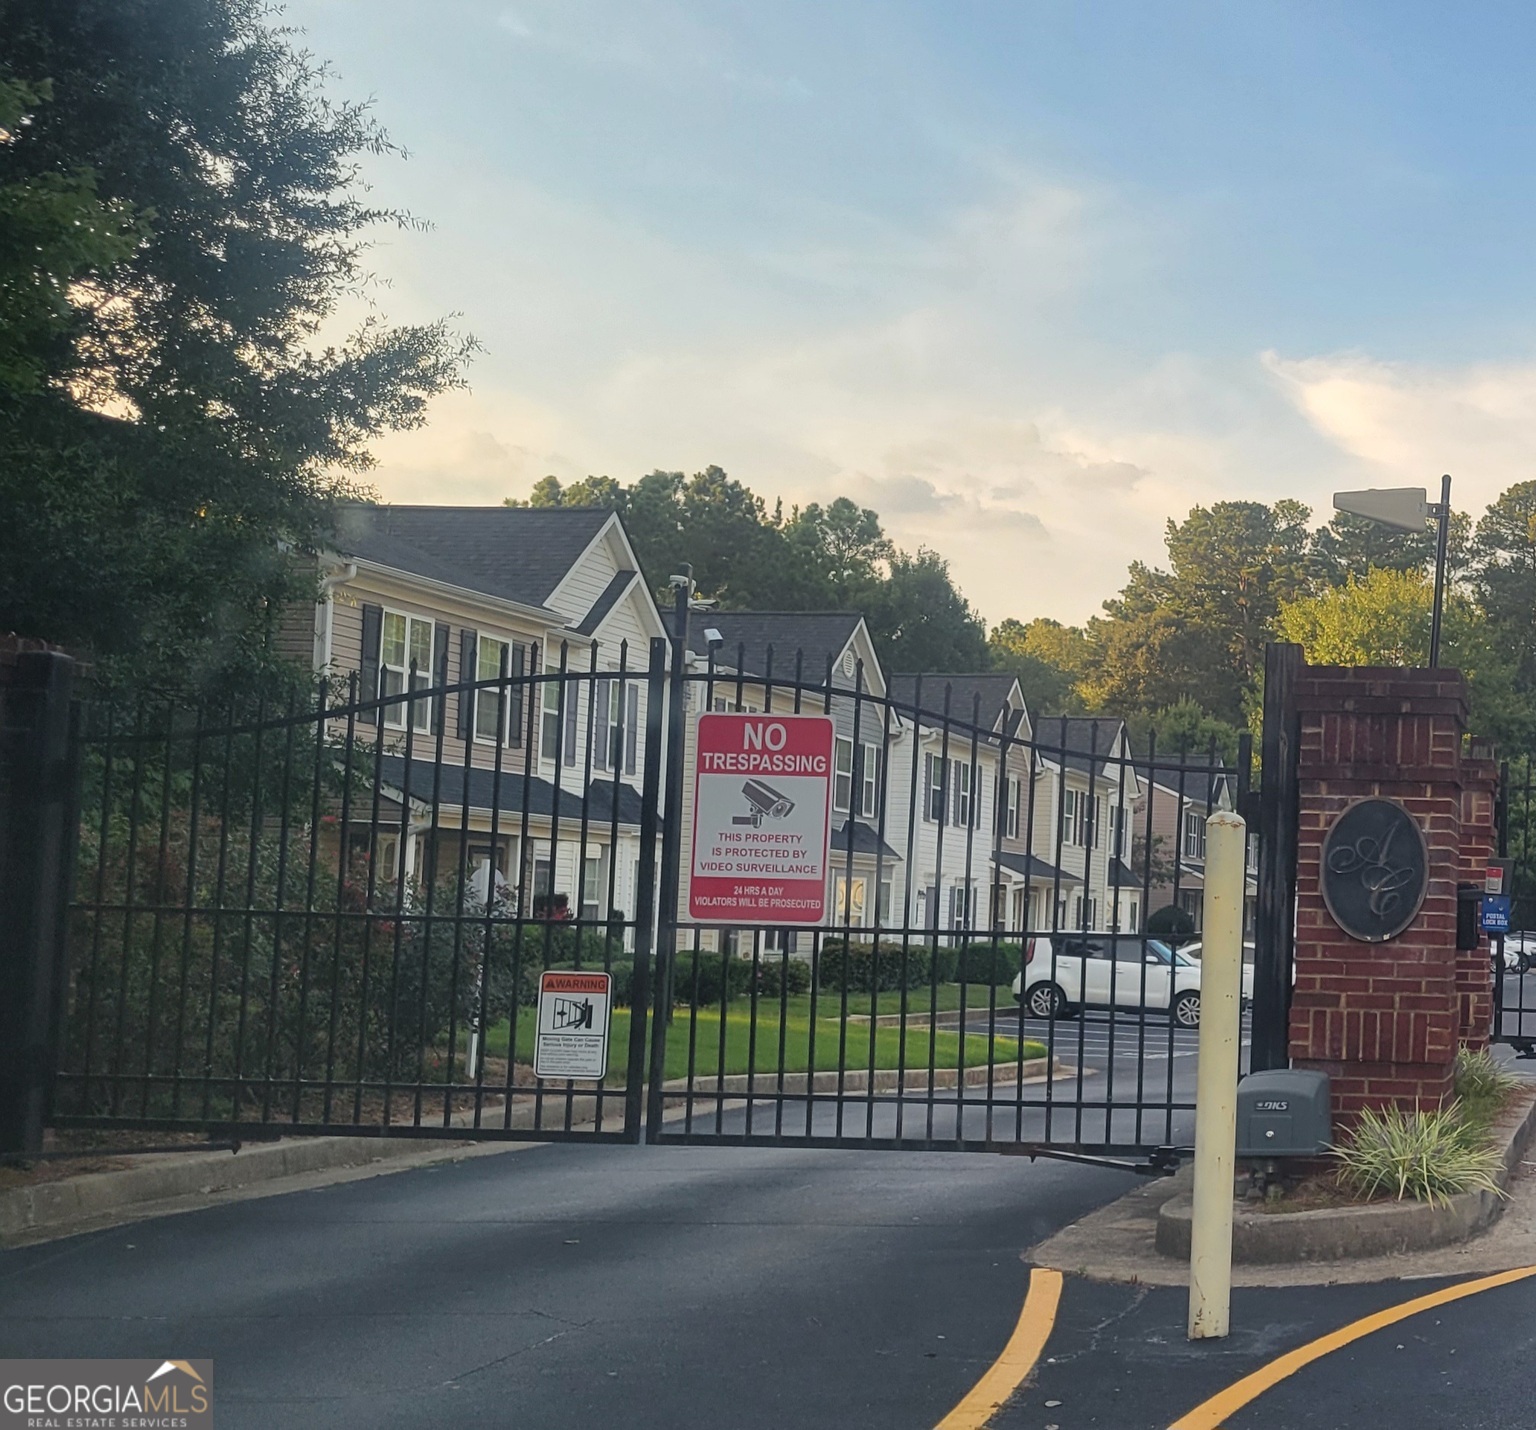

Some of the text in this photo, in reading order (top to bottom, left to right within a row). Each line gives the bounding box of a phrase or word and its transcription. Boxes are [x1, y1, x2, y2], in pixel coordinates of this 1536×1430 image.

[744, 723, 787, 751] NO
[702, 752, 826, 772] TRESPASSING
[719, 833, 802, 843] THIS PROPERTY
[712, 848, 807, 858] IS PROTECTED BY
[700, 862, 817, 873] VIDEO SURVEILLANCE
[734, 886, 784, 896] 24 HRS A DAY
[695, 897, 821, 908] VIOLATORS WILL BE PROSECUTED
[557, 980, 605, 989] WARNING
